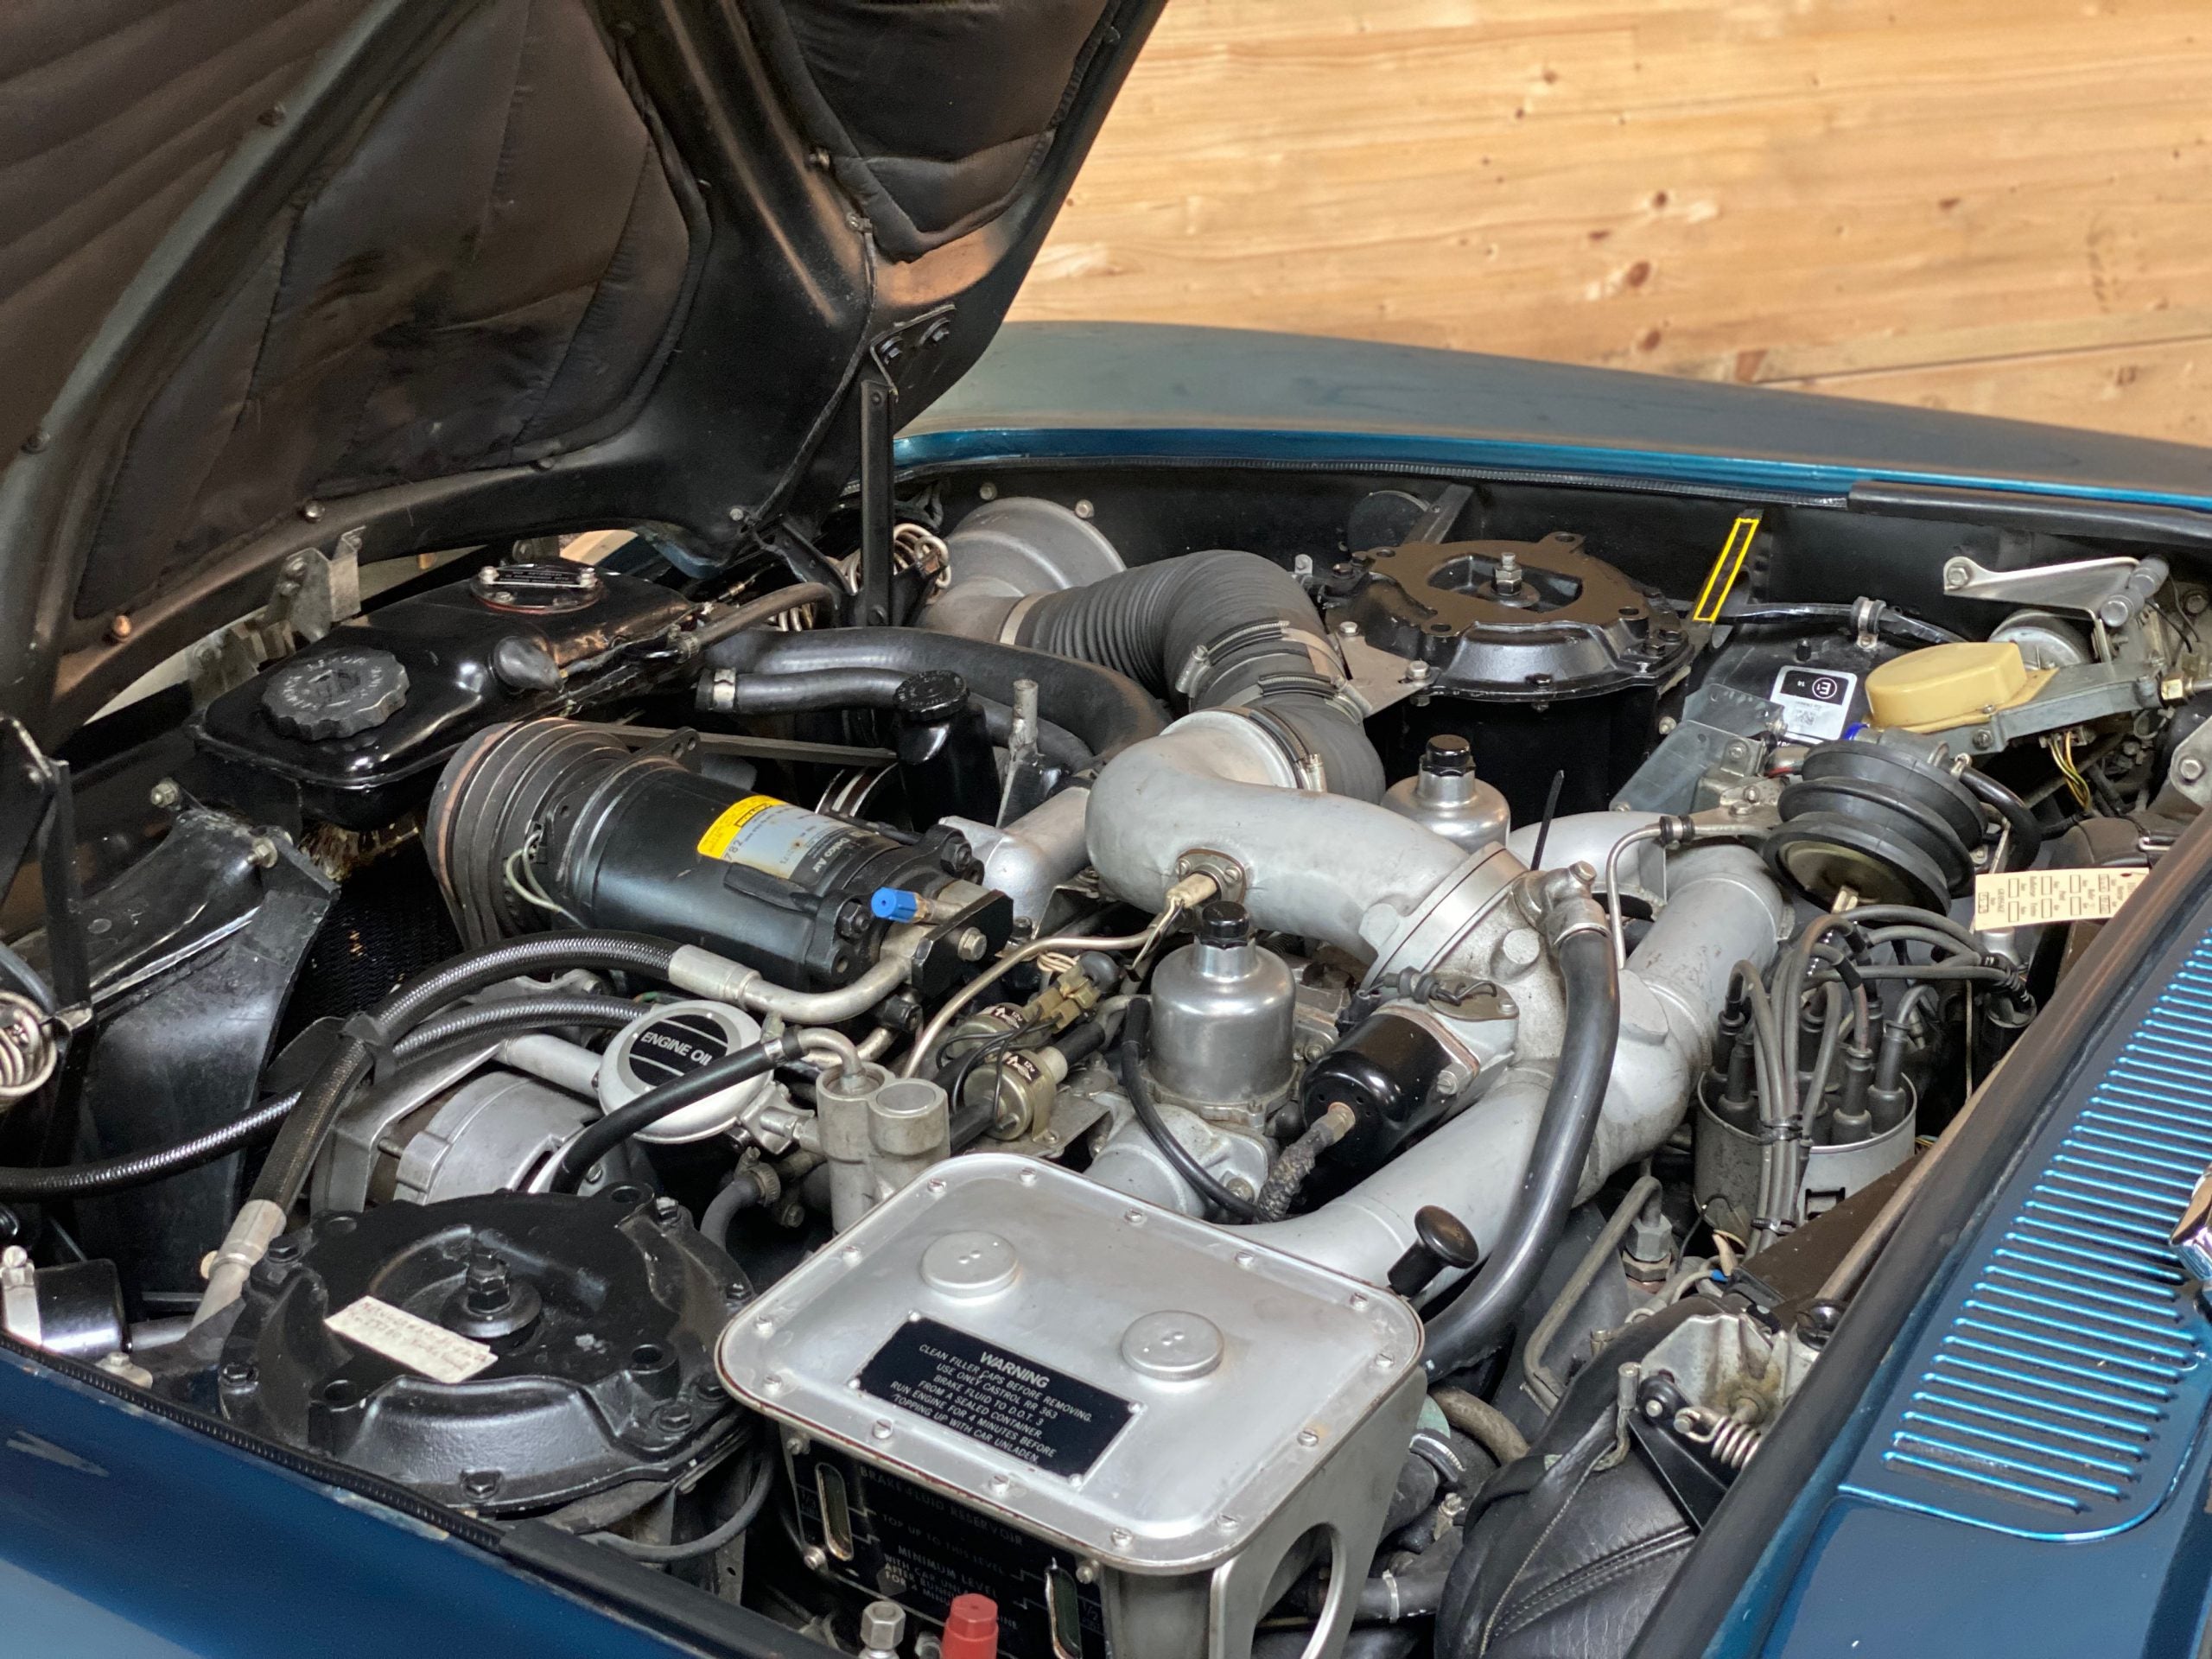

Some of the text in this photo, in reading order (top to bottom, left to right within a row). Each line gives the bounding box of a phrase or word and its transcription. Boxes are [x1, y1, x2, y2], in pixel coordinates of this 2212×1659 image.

[640, 1031, 693, 1057] ENGINE
[919, 1344, 1092, 1422] CLEAN FILLER CAPS BEFORE REMOVING.
[936, 1363, 1058, 1420] USE ONLY CASTROL RR 363
[980, 1351, 1050, 1388] WARNING
[890, 1381, 912, 1395] RUN
[912, 1389, 948, 1409] ENGINE
[947, 1404, 968, 1418] FOR
[976, 1417, 1019, 1440] MINUTES
[1020, 1436, 1057, 1458] BEFORE
[893, 1393, 933, 1416] TOPPING
[933, 1412, 949, 1421] UP
[949, 1418, 973, 1433] WITH
[973, 1429, 994, 1442] CAR
[918, 1380, 1043, 1440] FROM A SEALED CONTAINER.
[933, 1375, 965, 1392] BRAKE
[964, 1387, 992, 1404] FLUID
[994, 1399, 1007, 1410] TO
[1035, 1418, 1044, 1427] 3
[898, 1544, 957, 1580] MINIMUM
